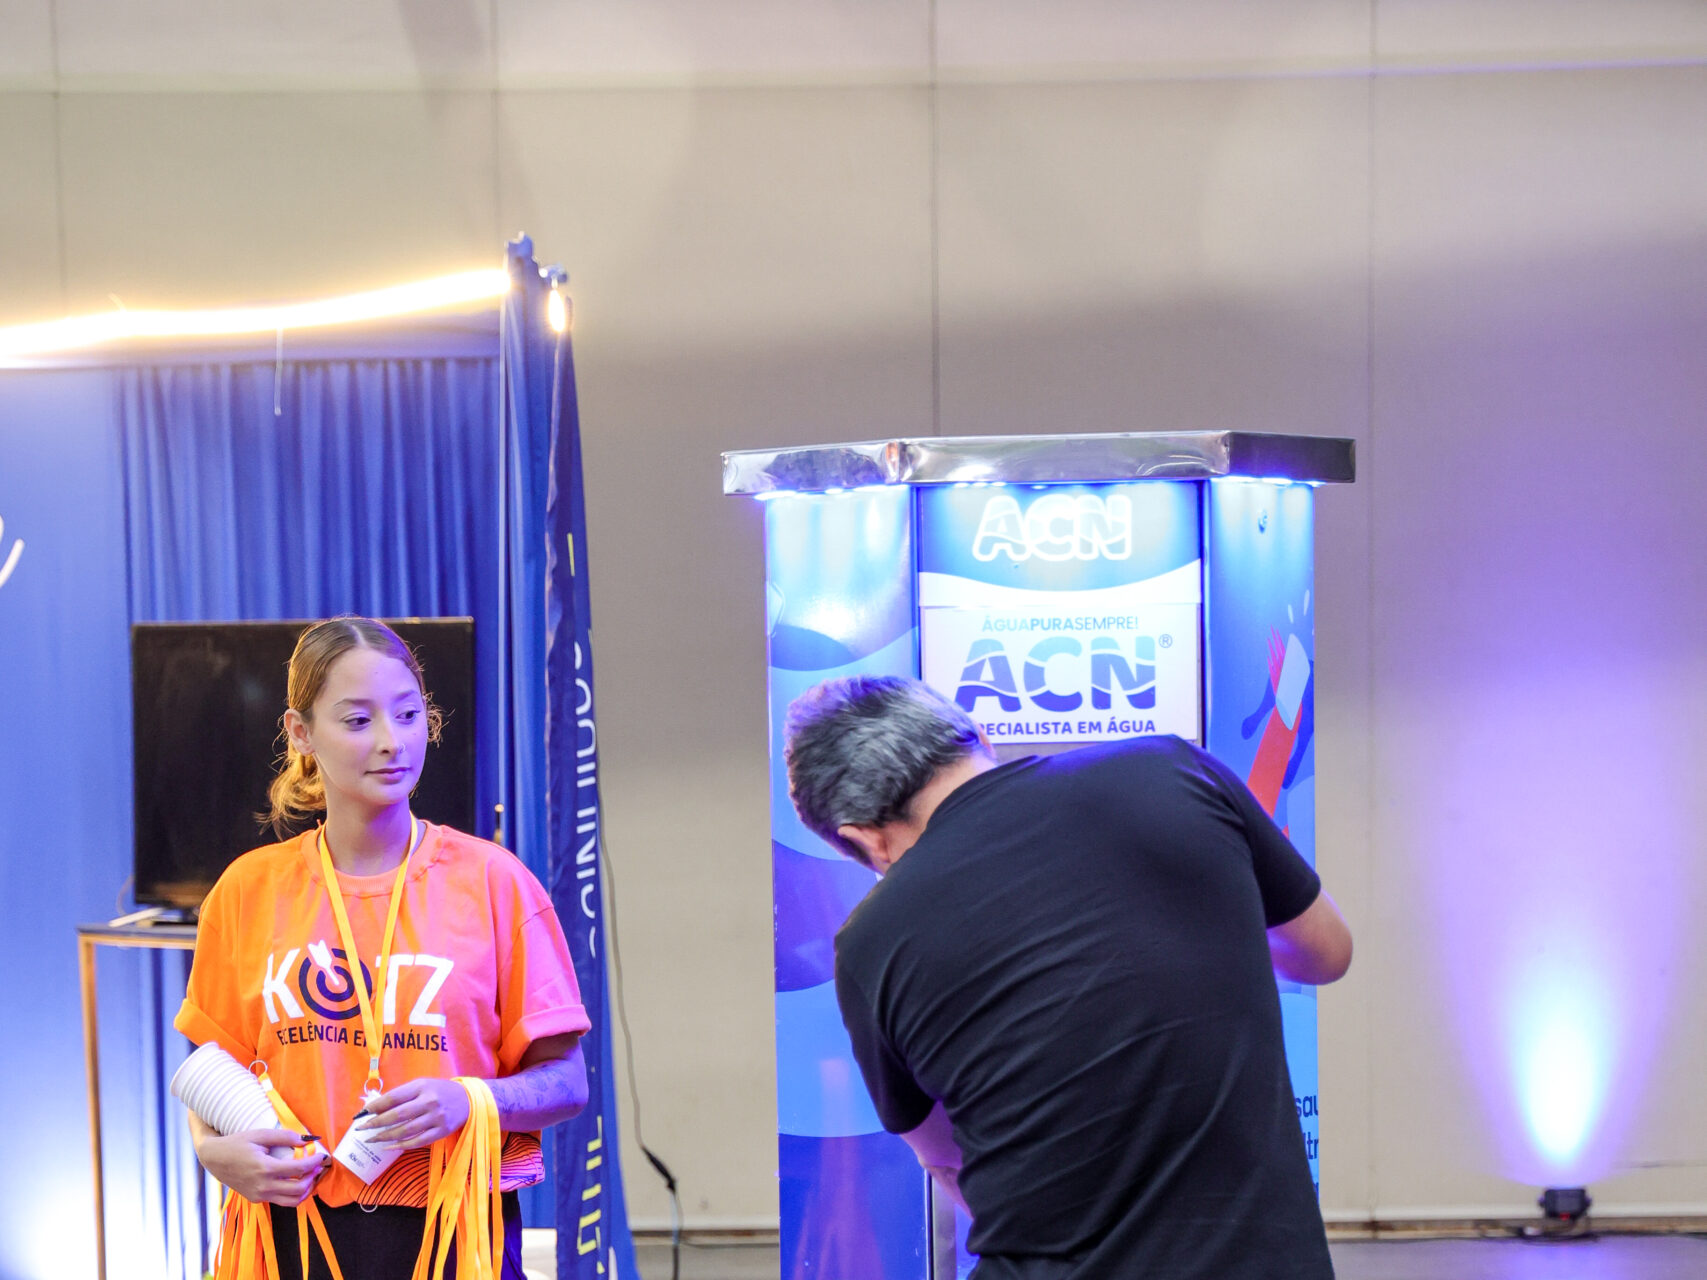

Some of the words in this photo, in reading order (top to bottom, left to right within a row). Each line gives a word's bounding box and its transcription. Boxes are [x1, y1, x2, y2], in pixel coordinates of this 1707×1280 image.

[972, 493, 1132, 562] ACN
[955, 635, 1156, 713] ACN
[979, 722, 1073, 736] ECIALISTA
[1077, 721, 1103, 734] EM
[1106, 716, 1157, 734] ÁGUA
[353, 1030, 368, 1047] E
[382, 1029, 449, 1052] ANÁLISE
